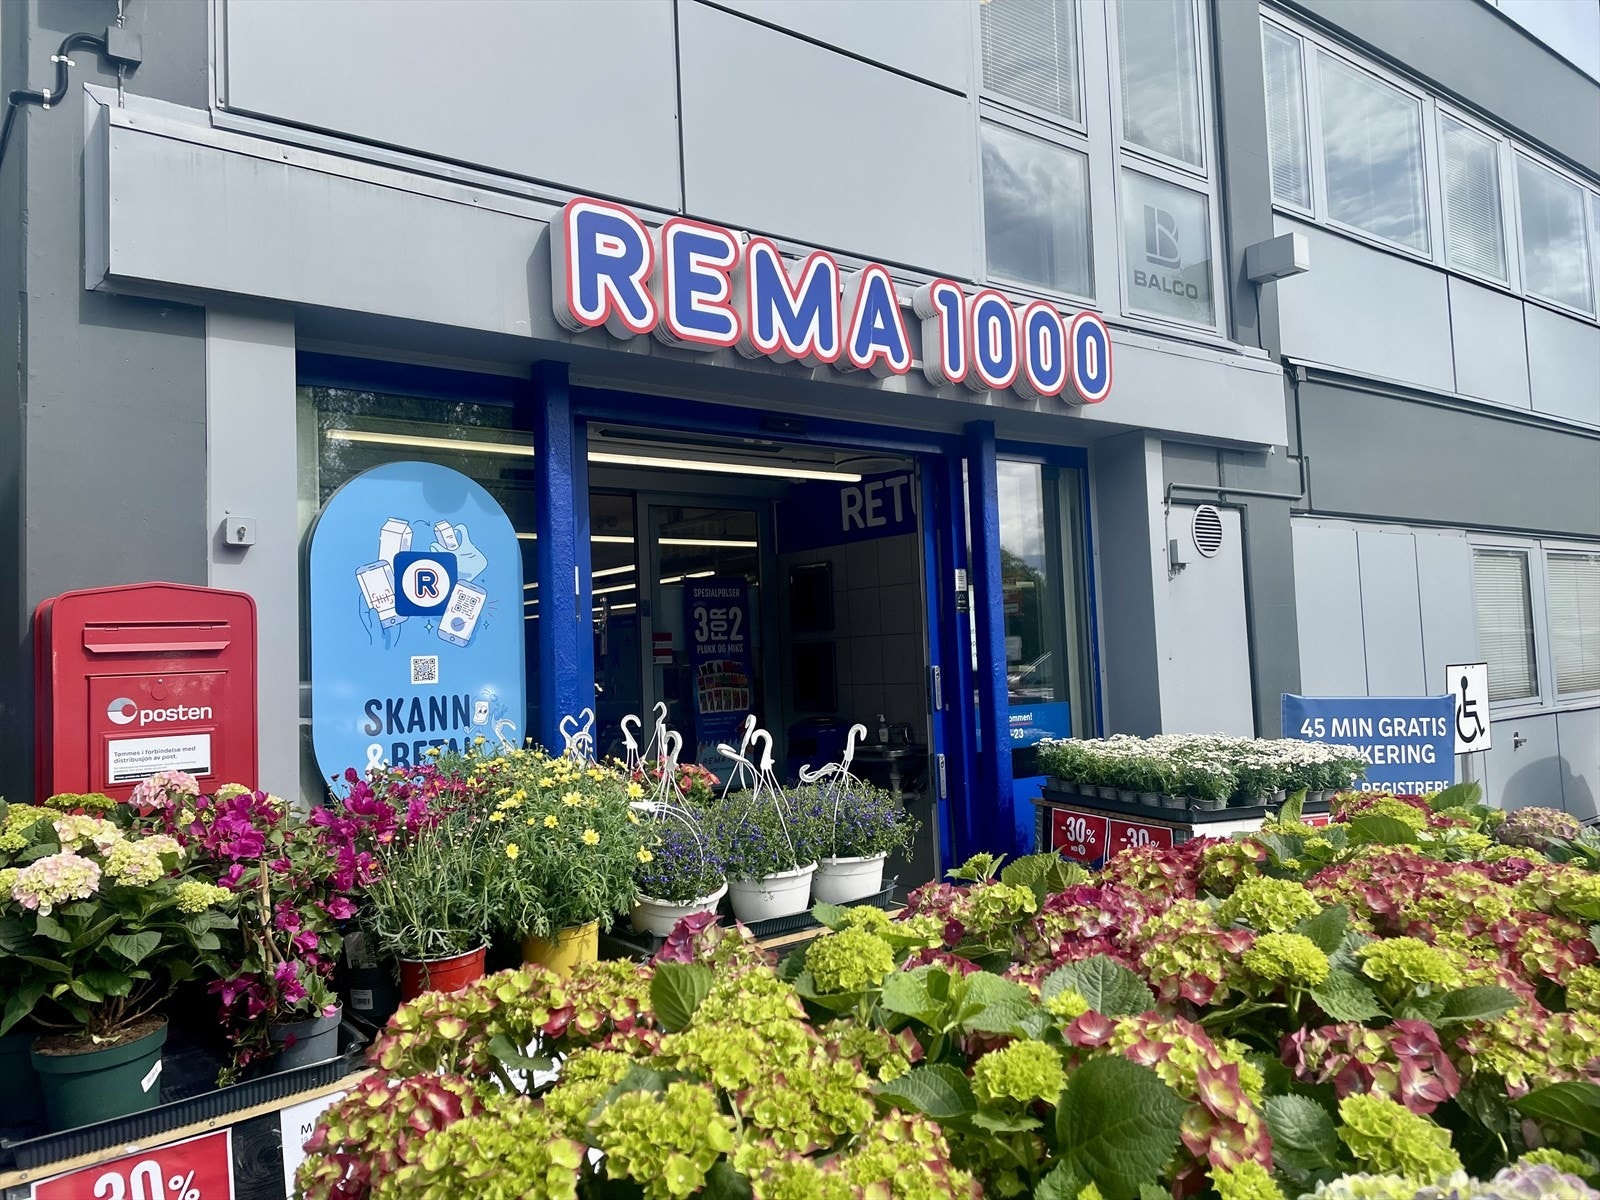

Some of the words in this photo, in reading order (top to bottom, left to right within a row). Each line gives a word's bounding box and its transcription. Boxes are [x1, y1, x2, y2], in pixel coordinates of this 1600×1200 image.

[1133, 269, 1198, 300] BALCO
[563, 196, 913, 374] REMA
[929, 278, 1113, 405] 1000
[694, 606, 709, 643] 3
[709, 607, 729, 642] FOR
[728, 606, 744, 642] 2
[717, 644, 728, 654] OG
[140, 704, 212, 726] posten
[364, 694, 471, 737] SKANN
[1008, 712, 1033, 723] ommen!
[1010, 727, 1025, 739] -23
[1300, 717, 1326, 739] 45
[1331, 717, 1373, 738] MIN
[1378, 716, 1447, 738] GRATIS
[145, 747, 181, 755] forbindelse
[1353, 743, 1436, 765] KERING
[1060, 816, 1096, 844] -30%
